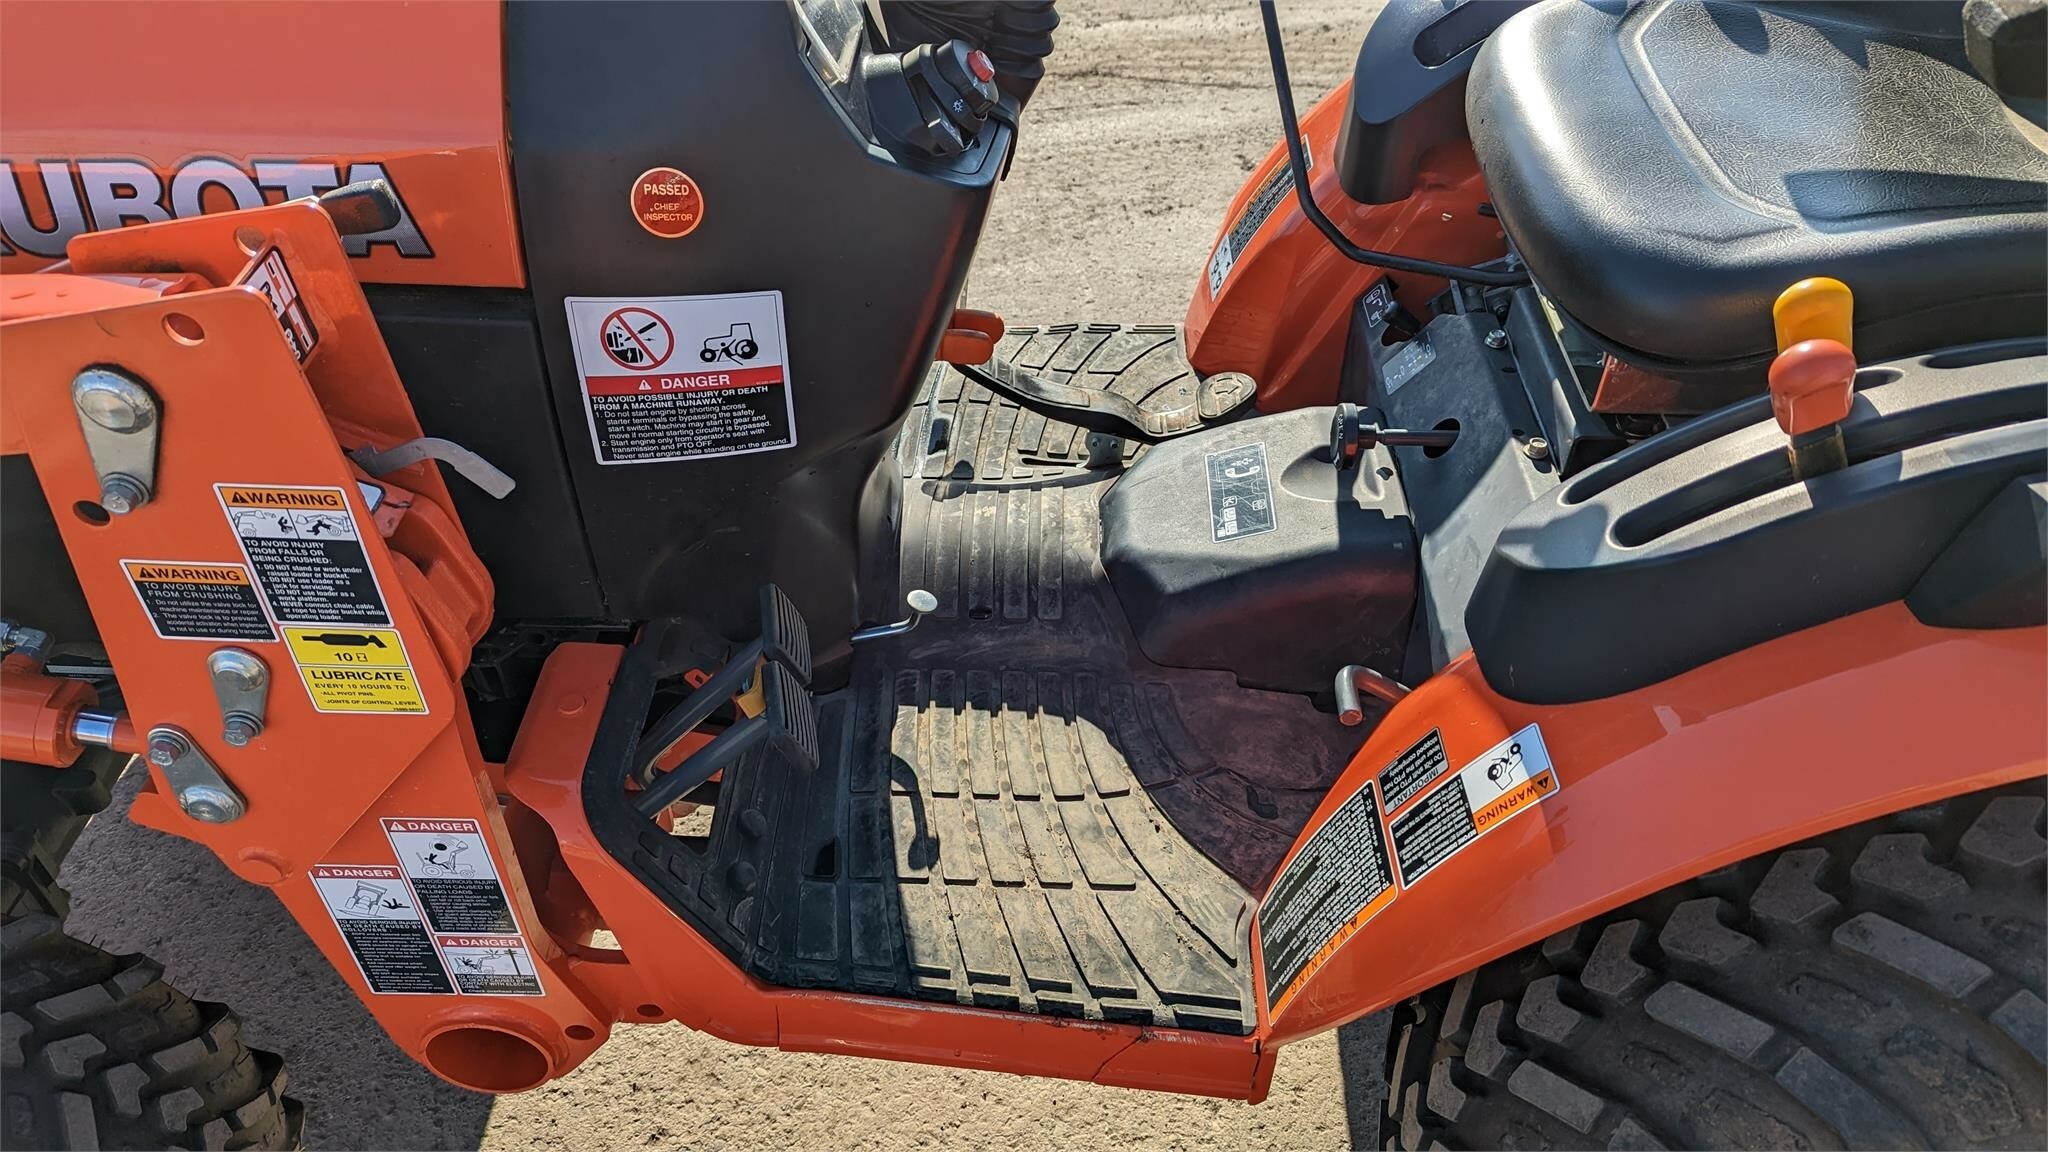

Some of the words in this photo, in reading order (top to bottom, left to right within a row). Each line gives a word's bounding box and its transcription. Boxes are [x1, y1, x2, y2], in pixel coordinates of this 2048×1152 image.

[644, 183, 690, 196] PASSED
[653, 202, 681, 211] CHIEF
[643, 213, 693, 221] INSPECTOR
[660, 374, 730, 389] DANGER
[607, 394, 635, 403] AVOID
[638, 392, 683, 402] POSSIBLE
[686, 389, 720, 398] INJURY
[737, 385, 768, 394] DEATH
[593, 402, 620, 411] FROM
[631, 400, 673, 410] MACHINE
[676, 396, 725, 407] RUNAWAY.
[632, 415, 667, 425] terminals
[678, 412, 717, 423] bypassing
[732, 409, 754, 417] safety
[650, 407, 675, 417] engine
[689, 405, 719, 414] shorting
[626, 423, 652, 432] switch.
[654, 421, 686, 430] Machine
[638, 430, 663, 438] normal
[665, 428, 693, 437] starting
[734, 420, 771, 431] bypassed.
[610, 438, 628, 447] Start
[630, 437, 655, 446] engine
[657, 436, 673, 444] only
[693, 432, 730, 442] operator's
[611, 443, 659, 454] transmission
[676, 441, 693, 449] PTO
[613, 452, 635, 460] Never
[655, 449, 681, 458] engine
[703, 444, 735, 454] standing
[761, 438, 788, 447] ground.
[245, 492, 338, 506] WARNING
[260, 539, 289, 547] AVOID
[290, 540, 325, 548] INJURY
[152, 567, 241, 580] WARNING
[199, 584, 241, 592] INJURY
[334, 652, 353, 661] 10
[310, 669, 405, 681] LUBRICATE
[1391, 766, 1438, 809] IMPORTANT
[1477, 786, 1538, 827] WARNING
[406, 822, 474, 831] DANGER
[459, 938, 518, 946] DANGER
[1290, 928, 1350, 995] WARNING
